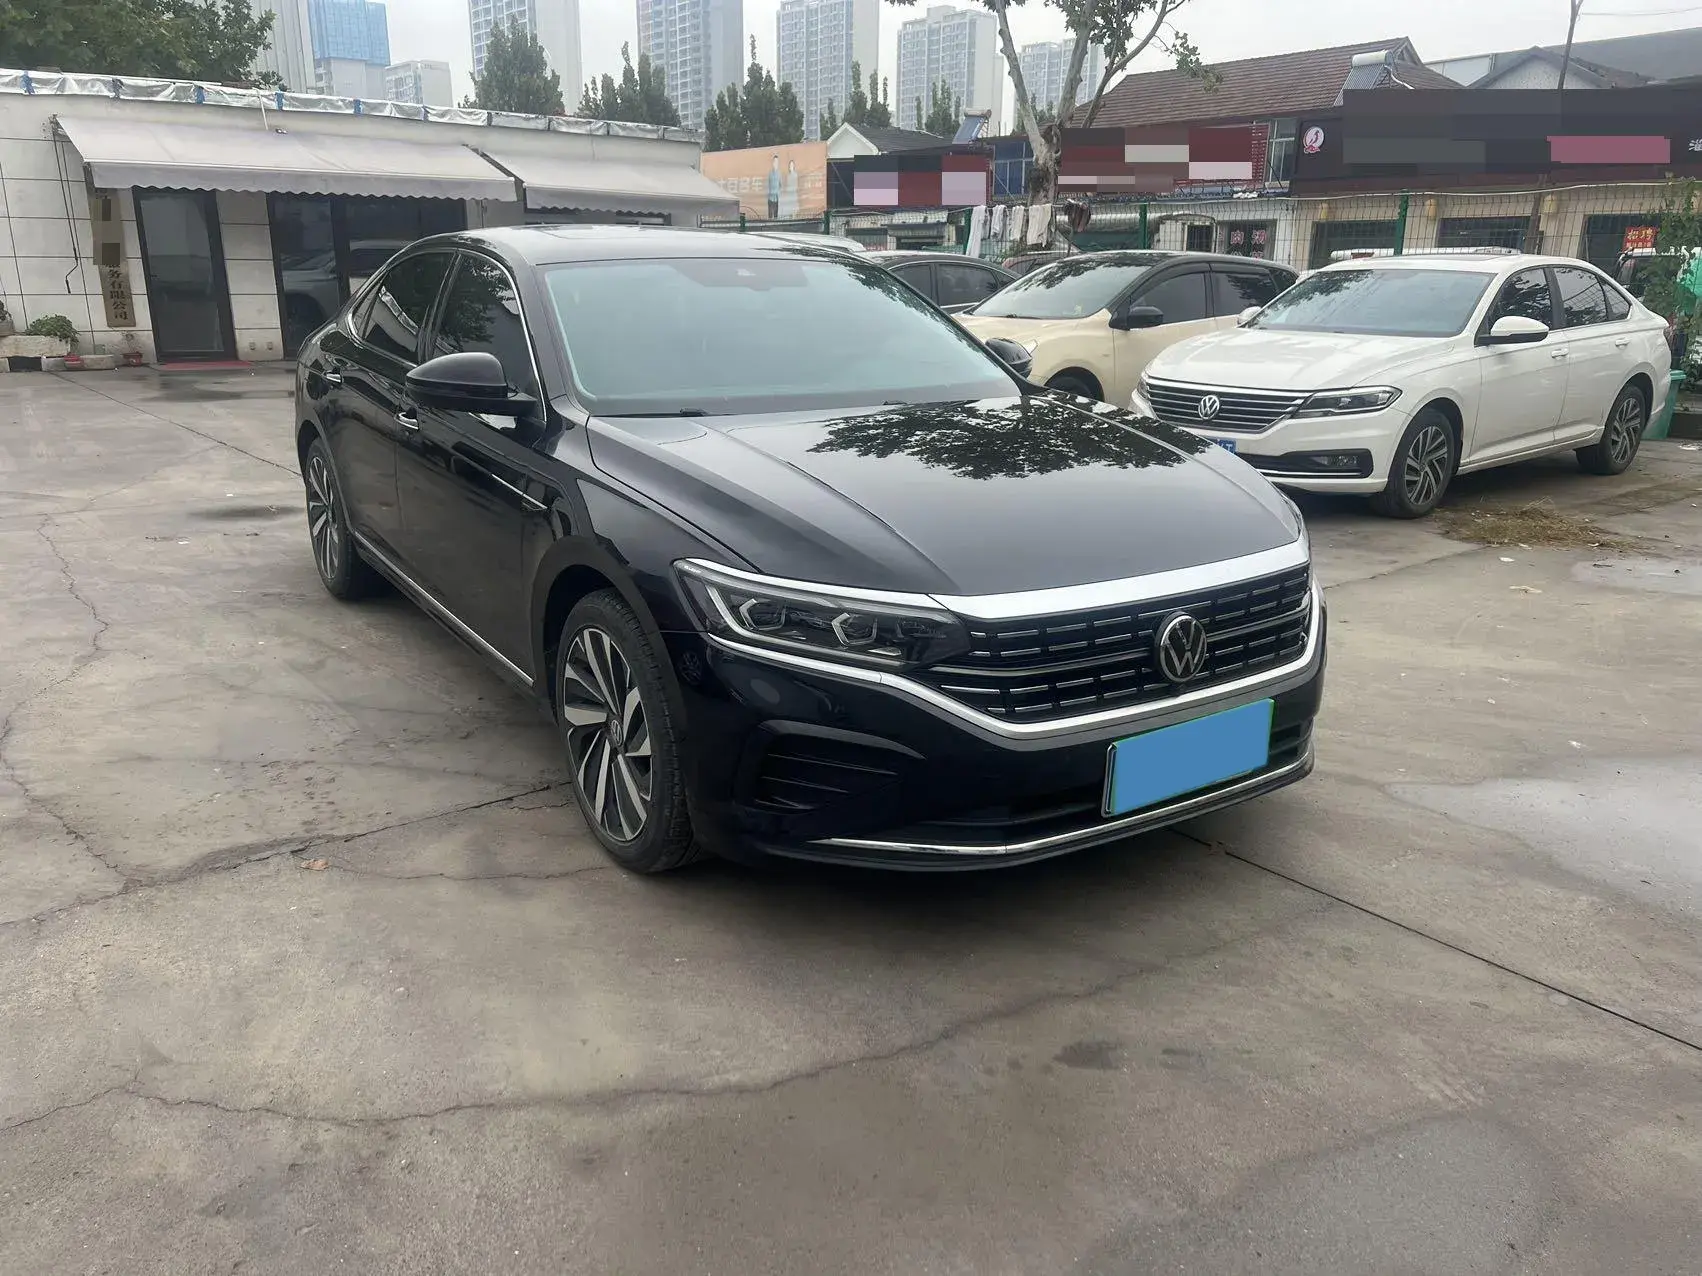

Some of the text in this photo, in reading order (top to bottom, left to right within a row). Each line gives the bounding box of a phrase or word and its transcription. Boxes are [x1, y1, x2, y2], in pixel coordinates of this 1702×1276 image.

[1627, 227, 1653, 240] 招聘
[106, 264, 129, 321] 务有限公司
